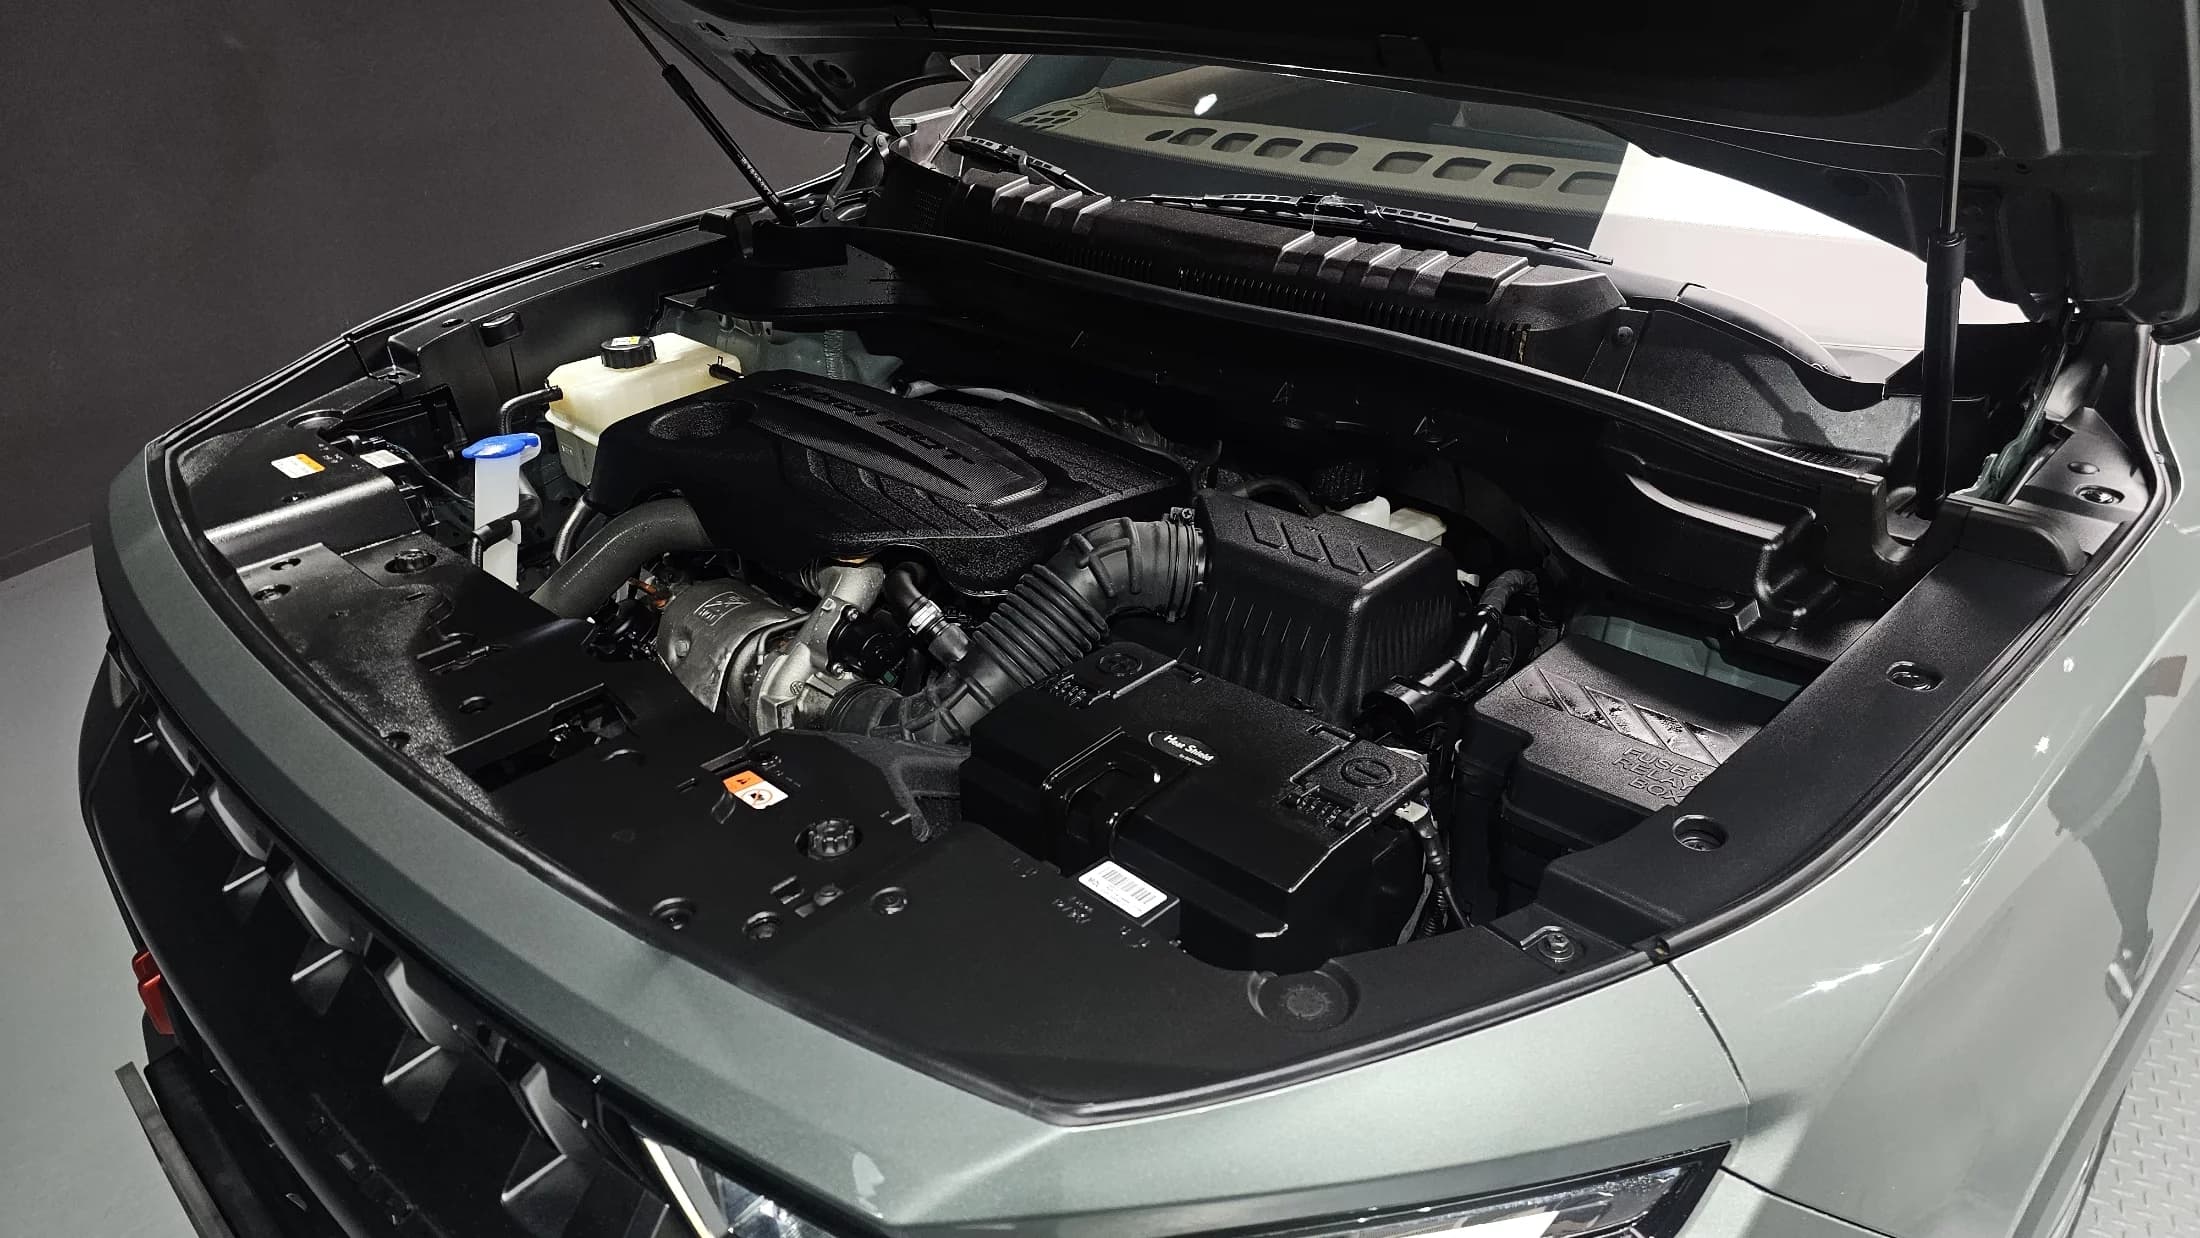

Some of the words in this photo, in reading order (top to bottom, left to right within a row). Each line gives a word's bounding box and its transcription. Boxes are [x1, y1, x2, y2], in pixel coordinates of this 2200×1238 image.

[1612, 757, 1696, 791] RELAY
[1622, 747, 1692, 777] FUSE
[1627, 777, 1687, 805] BOX
